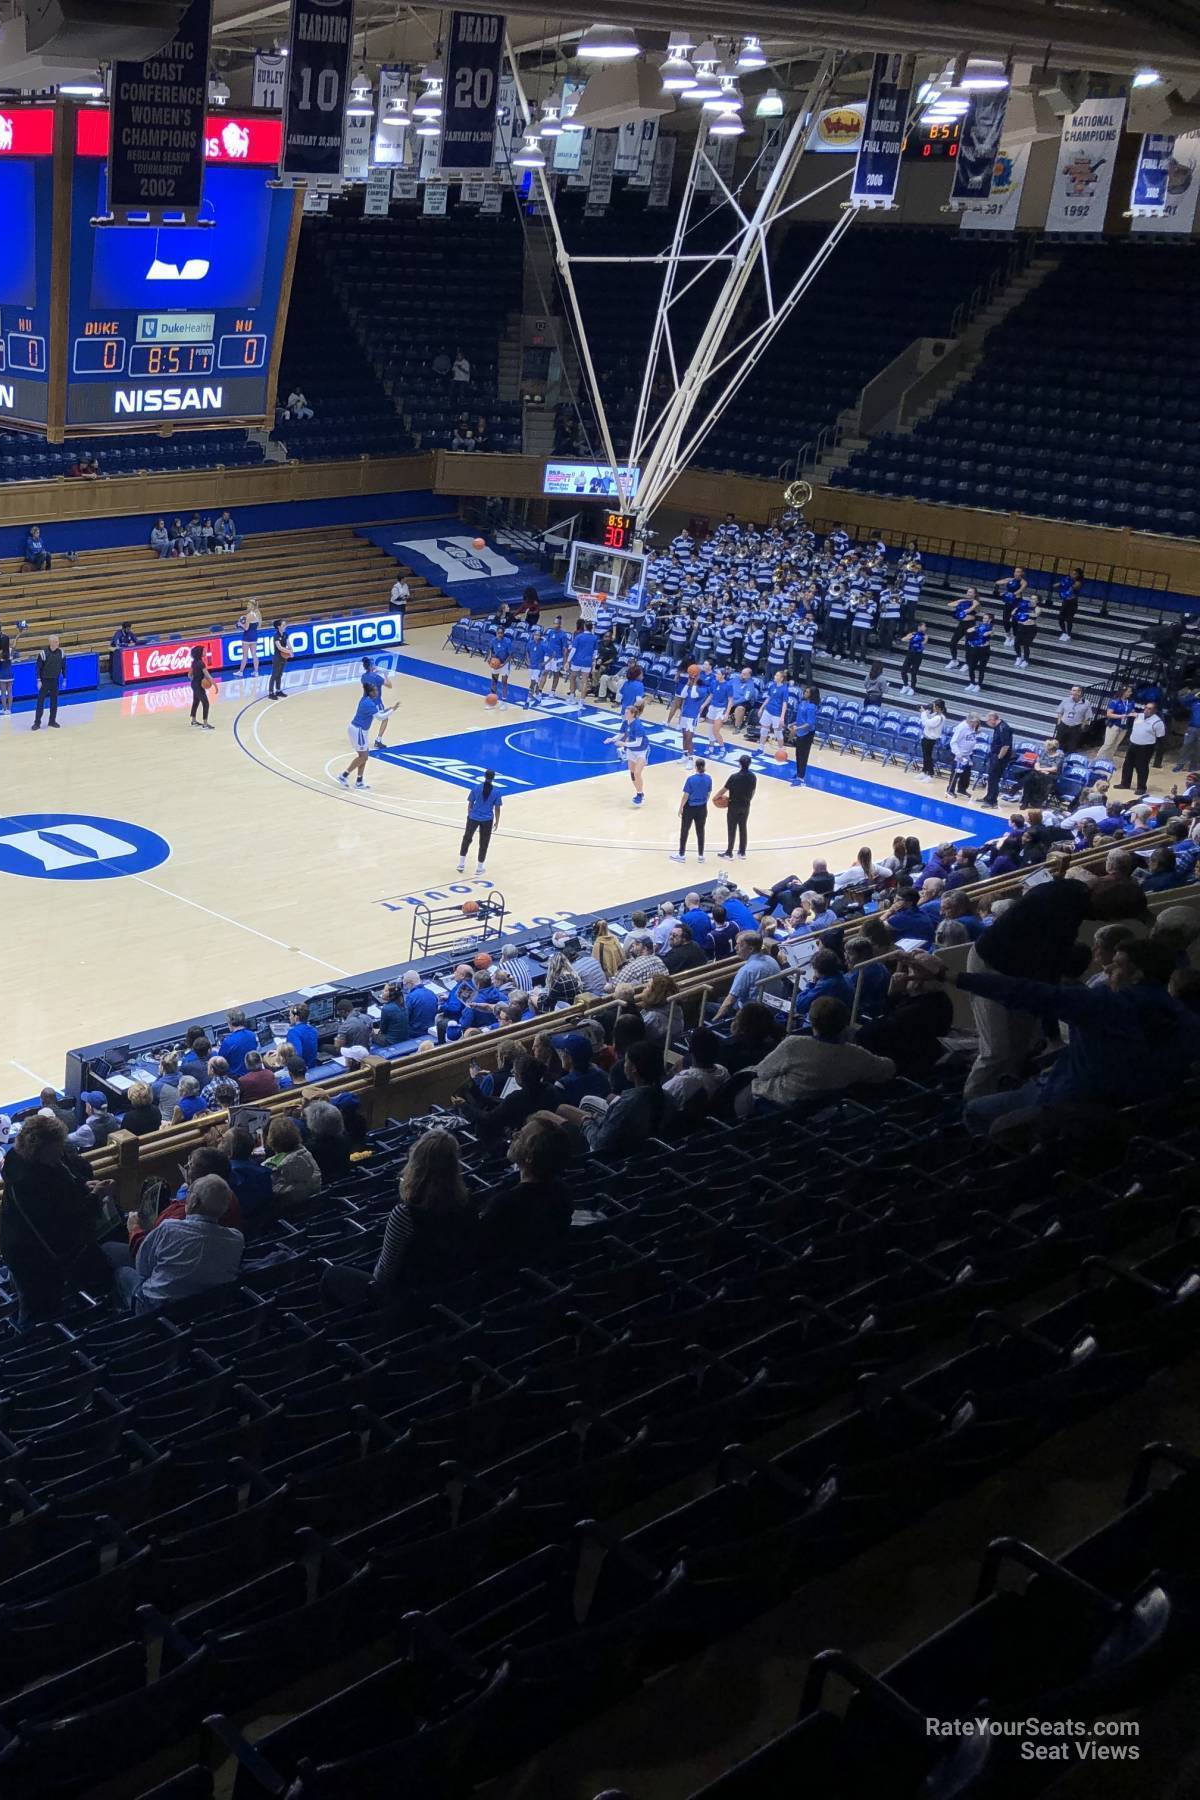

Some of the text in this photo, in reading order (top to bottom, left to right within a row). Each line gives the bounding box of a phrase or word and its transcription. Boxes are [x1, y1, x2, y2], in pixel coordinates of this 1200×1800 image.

[299, 12, 348, 44] HARDING
[458, 15, 498, 44] BEARD
[153, 41, 194, 61] ANTIC
[142, 62, 185, 82] COAST
[256, 68, 284, 86] HURLEY
[120, 82, 203, 106] CONFERENCE
[262, 88, 275, 108] 11
[298, 67, 339, 111] 10
[454, 67, 493, 109] 20
[131, 105, 192, 127] WOMEN'S
[1071, 115, 1114, 128] NATIONAL
[122, 127, 198, 149] CHAMPIONS
[929, 124, 959, 139] 8:51
[1064, 128, 1117, 143] CHAMPIONS
[863, 140, 900, 154] FINAL FOUR
[139, 177, 176, 197] 2002
[1063, 204, 1091, 217] 1992
[18, 318, 32, 332] NU
[84, 322, 120, 336] DUKE
[160, 322, 212, 334] DukeHealth
[235, 319, 253, 332] NU
[28, 339, 38, 367] 0
[103, 341, 117, 369] 0
[148, 347, 195, 374] 8:51
[195, 348, 213, 356] PERIOD
[244, 338, 258, 364] 0
[114, 387, 223, 413] NISSAN
[608, 514, 630, 529] 8:51
[604, 526, 624, 548] 30
[316, 620, 397, 649] GEICO
[228, 632, 308, 662] GEIO
[146, 646, 193, 673] Coca-Col
[380, 879, 495, 912] COURT
